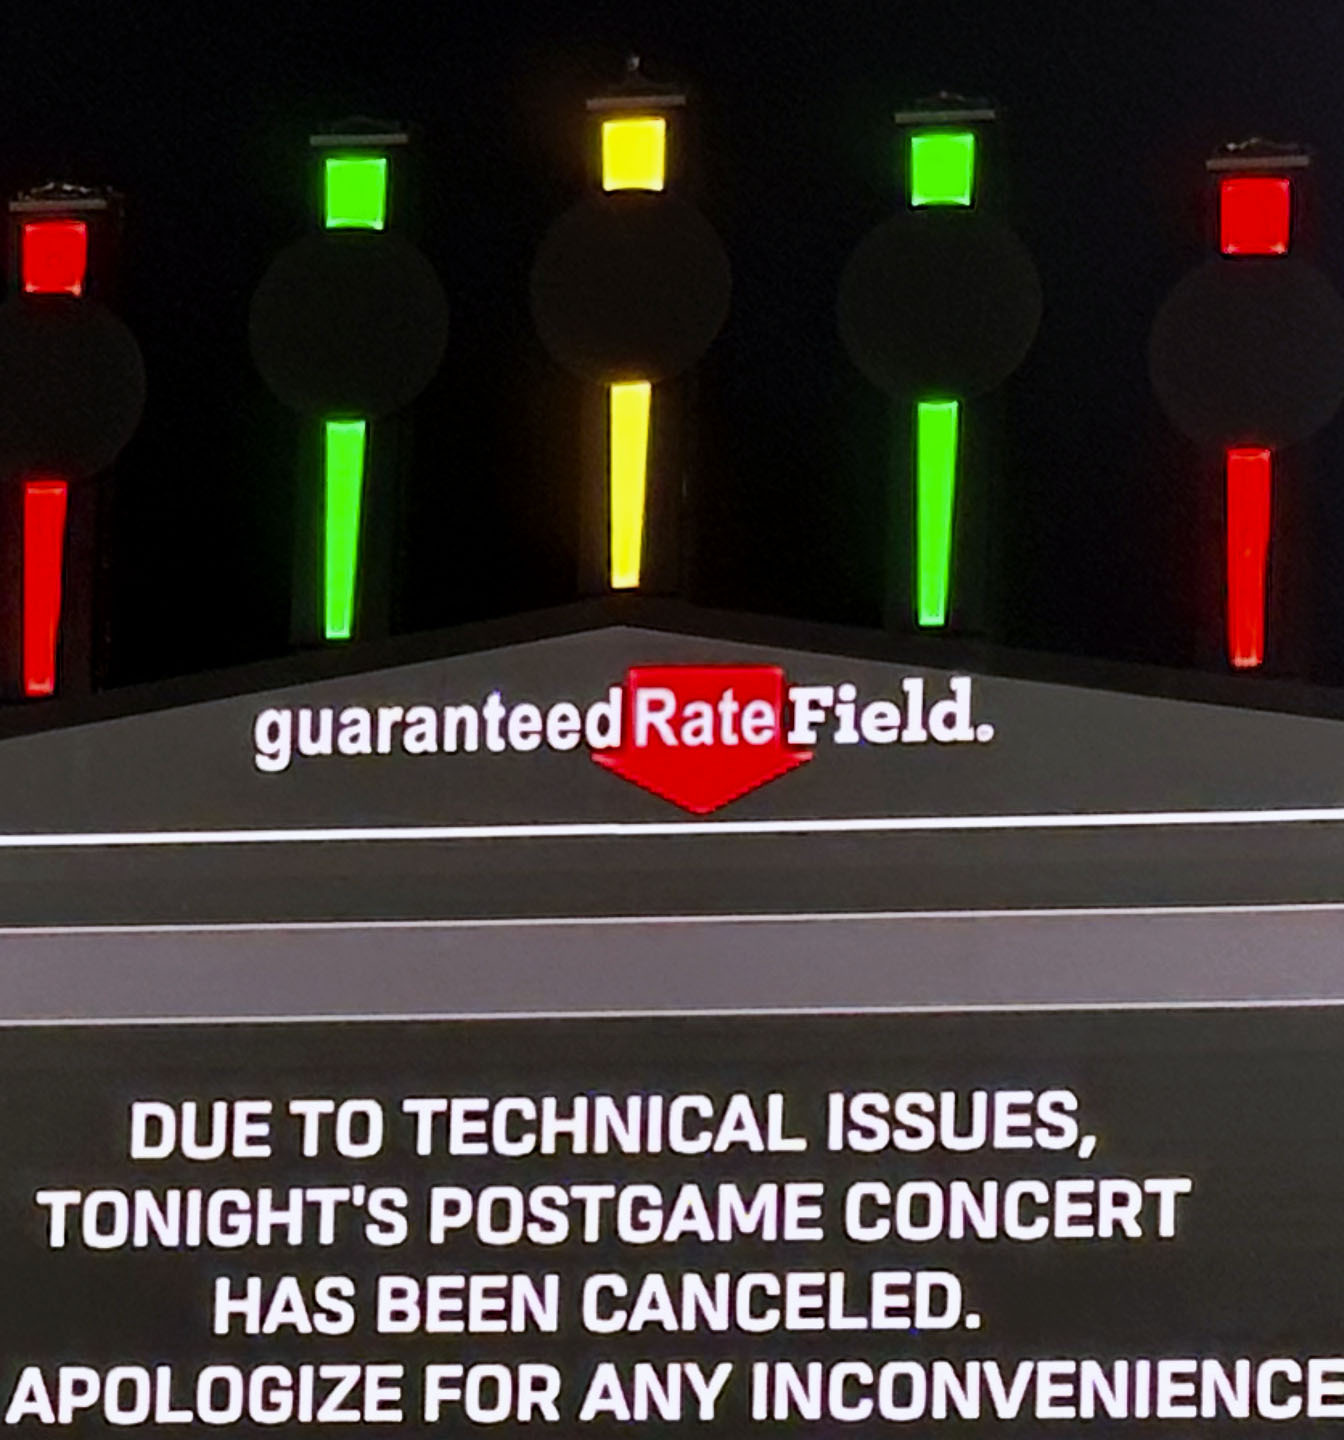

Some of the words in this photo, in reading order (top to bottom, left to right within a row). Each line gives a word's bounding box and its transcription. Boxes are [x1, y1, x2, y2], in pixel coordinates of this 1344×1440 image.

[255, 688, 623, 772] guaranteed
[636, 688, 775, 746] Rate
[787, 676, 995, 745] Field.
[130, 1100, 273, 1160] DUE
[289, 1099, 384, 1158] TO
[402, 1093, 807, 1156] TECHNICAL
[828, 1090, 1097, 1159] ISSUES,
[36, 1184, 408, 1249] TONIGHT'S
[430, 1182, 824, 1245] POSTGAME
[845, 1178, 1192, 1242] CONCERT
[214, 1276, 355, 1335] HAS
[377, 1274, 559, 1333] BEEN
[582, 1271, 980, 1333] CANCELED.
[5, 1364, 404, 1425] APOLOGIZE
[424, 1363, 561, 1423] FOR
[579, 1362, 733, 1421] ANY
